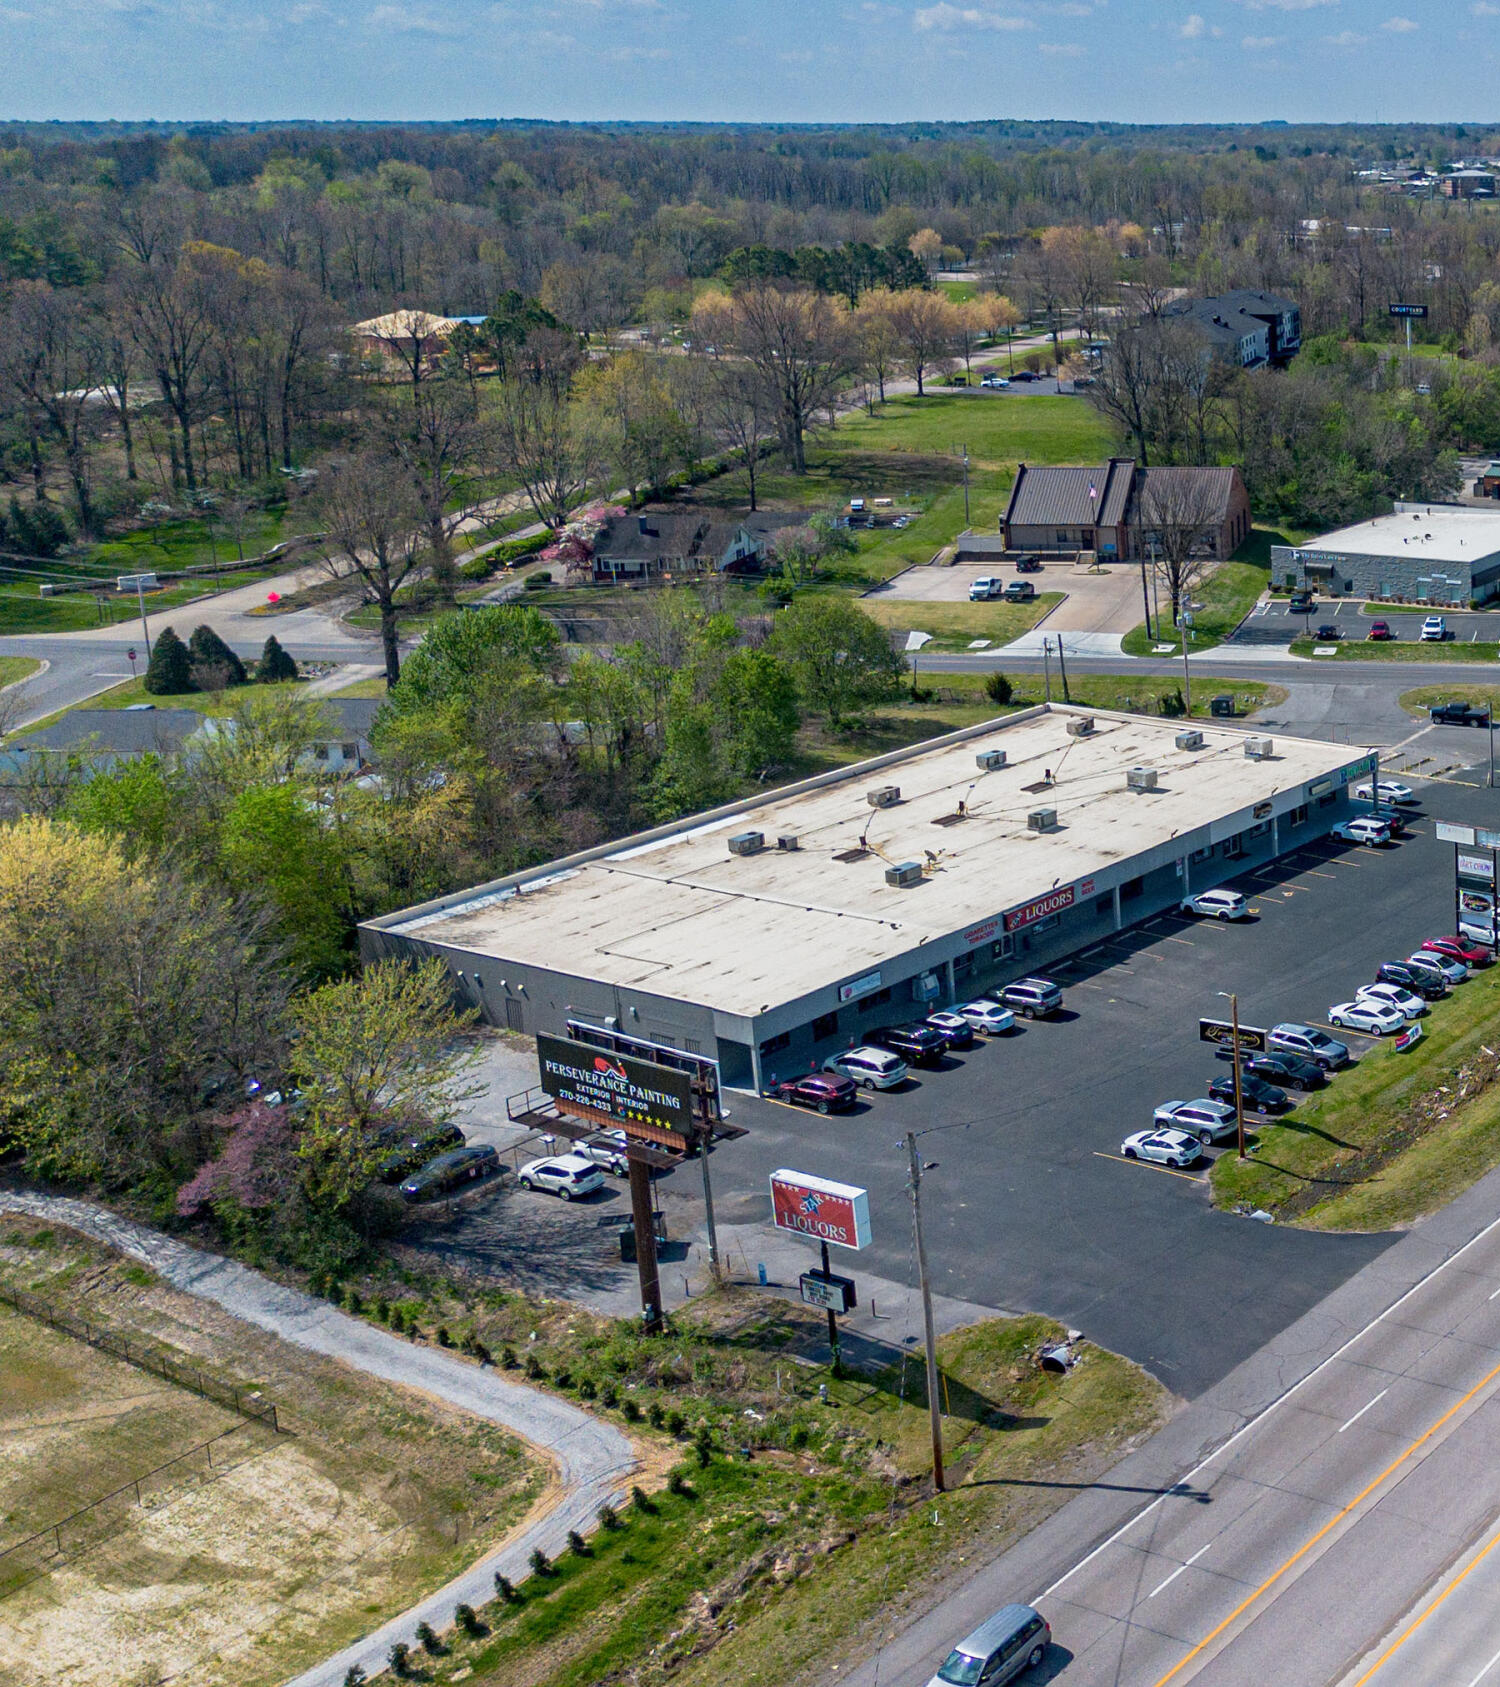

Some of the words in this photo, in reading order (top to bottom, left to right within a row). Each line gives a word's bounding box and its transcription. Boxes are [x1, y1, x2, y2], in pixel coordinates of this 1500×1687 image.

[1025, 890, 1073, 921] LIQUORS
[545, 1059, 628, 1094] PERSEVERANCE
[629, 1084, 681, 1109] PAINTING
[576, 1083, 611, 1101] EXTERIOR
[615, 1095, 649, 1112] INTERIOR
[800, 1192, 824, 1216] STAR
[783, 1211, 848, 1241] LIQUORS
